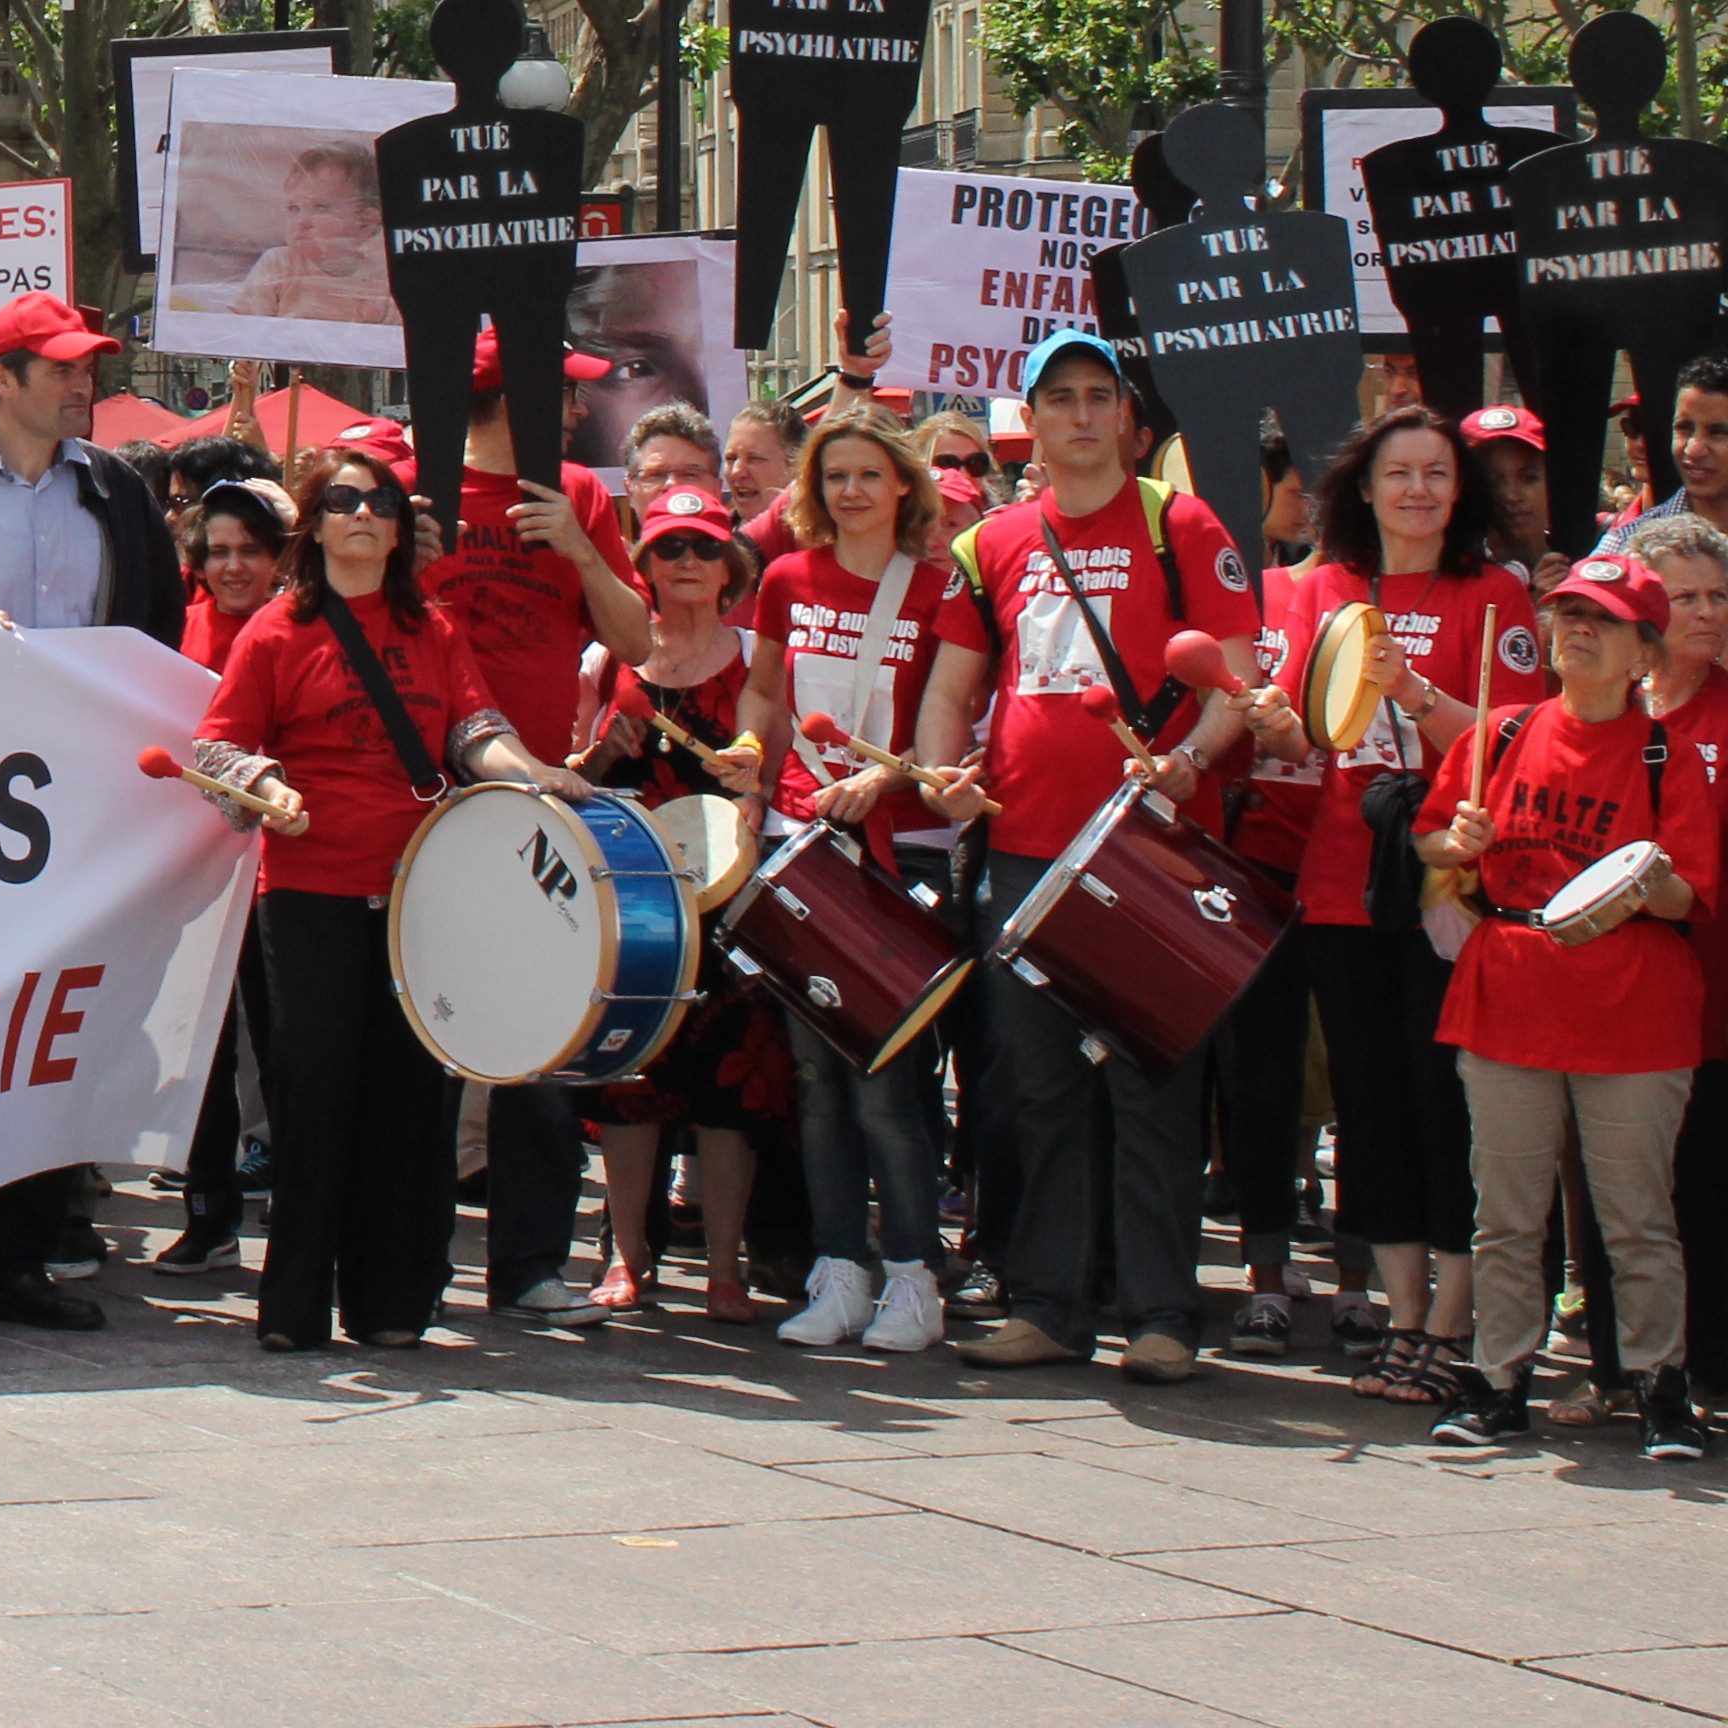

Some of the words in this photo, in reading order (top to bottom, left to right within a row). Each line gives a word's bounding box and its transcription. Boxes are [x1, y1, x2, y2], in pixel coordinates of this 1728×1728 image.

[738, 30, 919, 63] PSYCHIATRIE
[450, 121, 510, 153] TUÉ
[1437, 141, 1499, 171] TUÉ
[1587, 146, 1651, 179] TUÉ
[422, 174, 480, 202] PAR
[498, 170, 539, 196] LA
[1412, 190, 1472, 218] PAR
[1556, 201, 1619, 230] PAR
[1638, 196, 1682, 223] LA
[394, 216, 576, 254] PSYCHIATRIE
[1201, 223, 1269, 258] TUÉ
[1039, 238, 1098, 272] NOS
[1527, 241, 1720, 284] PSYCHIATRIE
[1178, 276, 1243, 305] PAR
[1260, 268, 1306, 294] LA
[1154, 306, 1355, 356] PSYCHIATRIE
[790, 602, 837, 629] Halte
[1512, 780, 1621, 835] HALTE
[517, 824, 578, 902] NP
